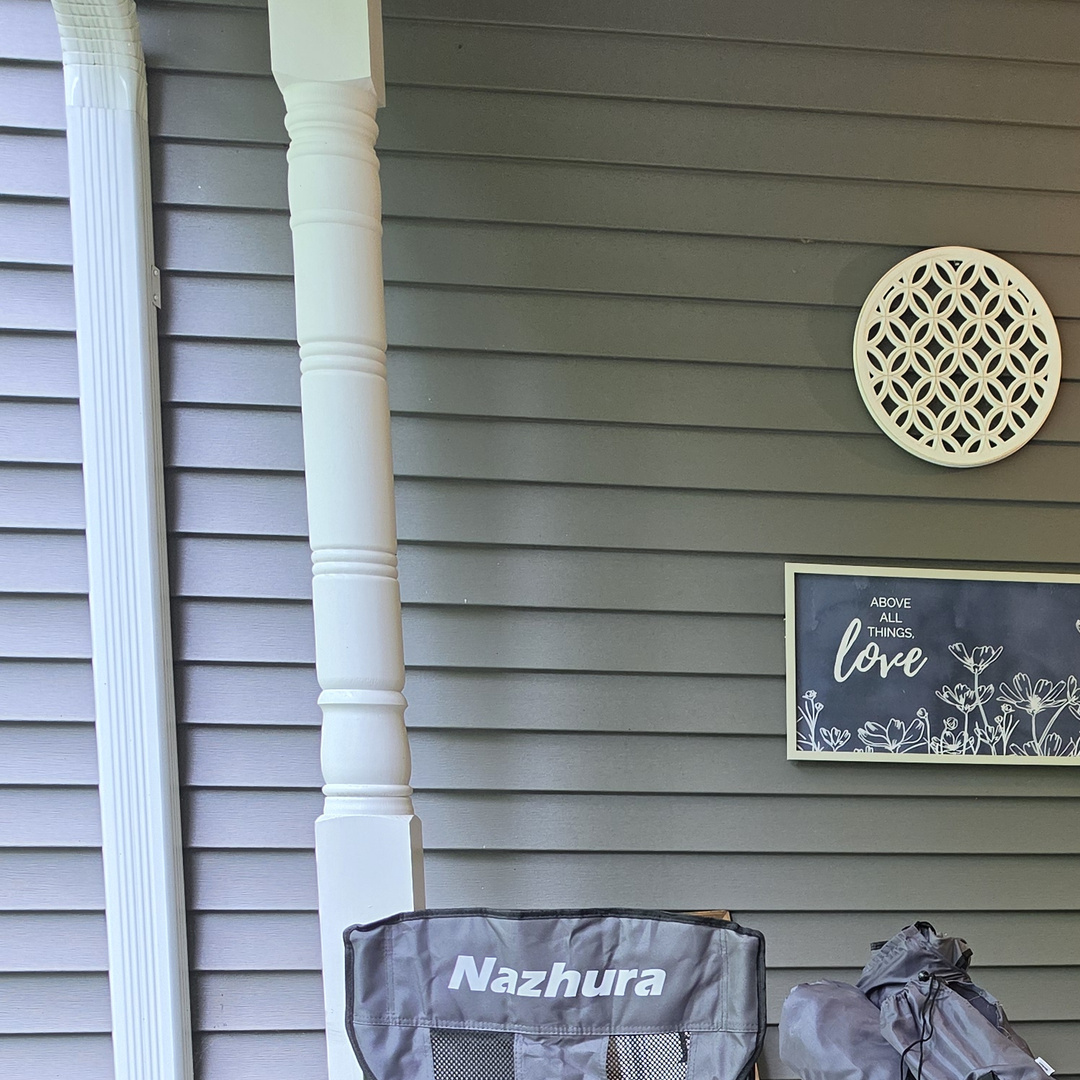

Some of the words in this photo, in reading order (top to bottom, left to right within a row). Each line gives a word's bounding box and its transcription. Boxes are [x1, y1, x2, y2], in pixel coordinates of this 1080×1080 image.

[870, 596, 912, 609] ABOVE
[879, 612, 903, 624] ALL
[867, 626, 915, 640] THINGS,
[833, 617, 928, 683] love
[448, 955, 667, 998] Nazhura
